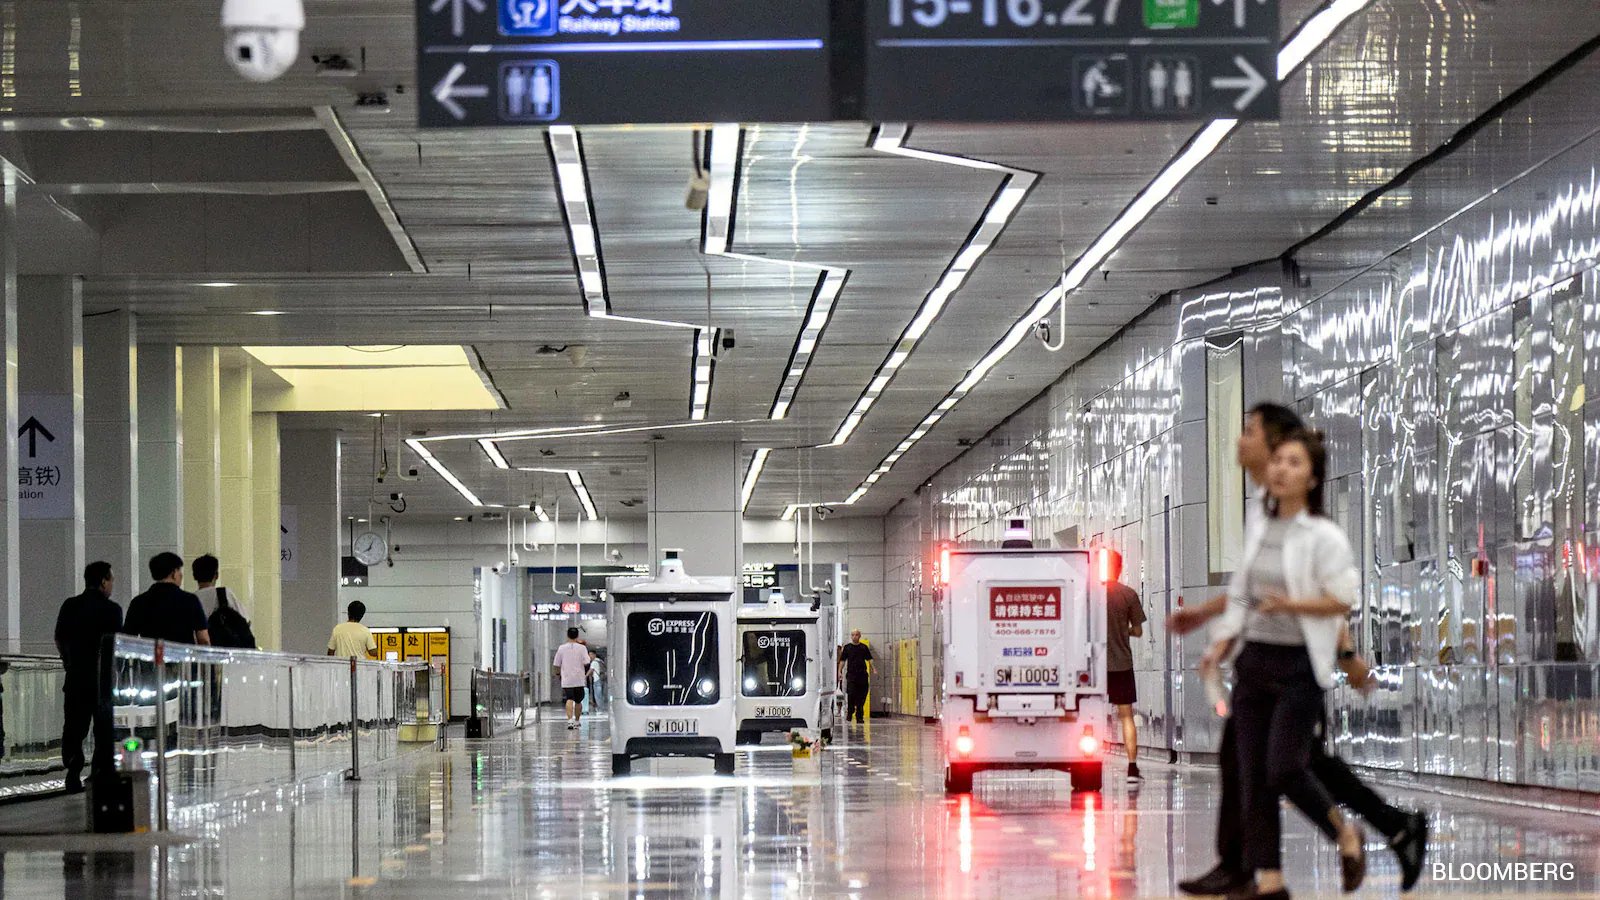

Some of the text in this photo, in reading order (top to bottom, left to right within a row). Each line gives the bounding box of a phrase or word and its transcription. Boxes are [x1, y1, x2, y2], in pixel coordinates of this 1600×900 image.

[621, 14, 680, 32] Station
[995, 604, 1056, 617] 请保持车距
[387, 635, 418, 646] 包 处
